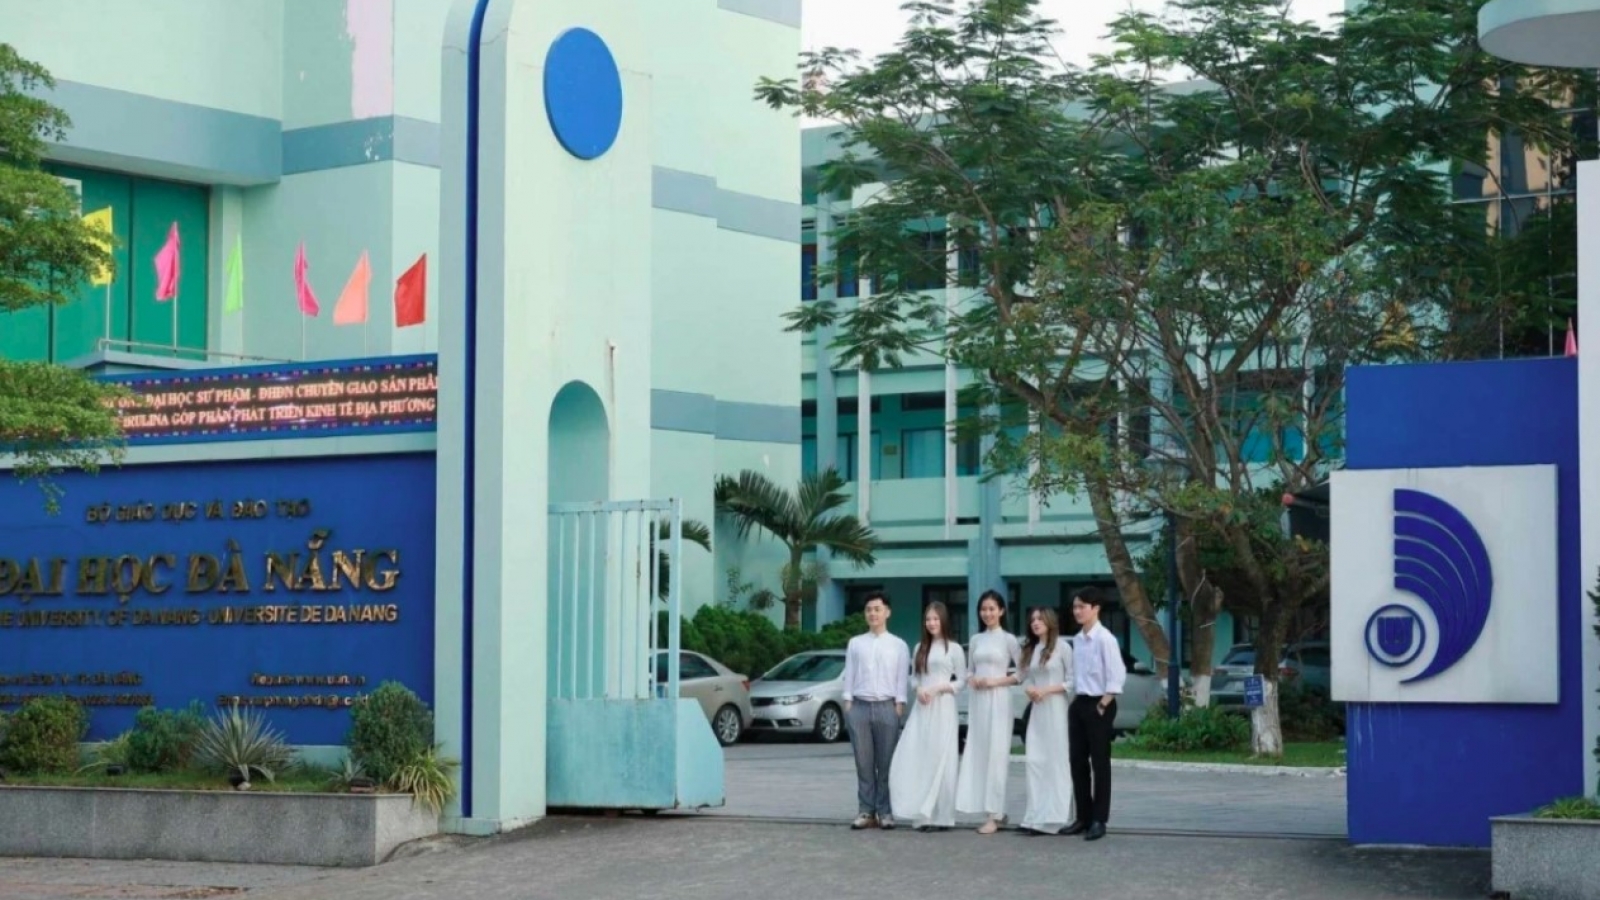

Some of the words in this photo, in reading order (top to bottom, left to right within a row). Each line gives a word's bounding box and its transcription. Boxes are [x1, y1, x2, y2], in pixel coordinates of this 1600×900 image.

[168, 391, 195, 408] HỌC
[196, 388, 214, 404] SƯ
[215, 387, 250, 408] PHẠM
[346, 380, 378, 394] GIAO
[171, 410, 196, 425] GÓP
[305, 402, 337, 417] KINH
[355, 401, 378, 418] ĐỊA
[380, 397, 436, 414] PHƯƠNG
[76, 553, 176, 603] HỌC
[186, 538, 250, 593] ĐÀ
[17, 608, 103, 627] UNIVERSITY
[107, 609, 131, 626] OF
[300, 604, 322, 623] DE
